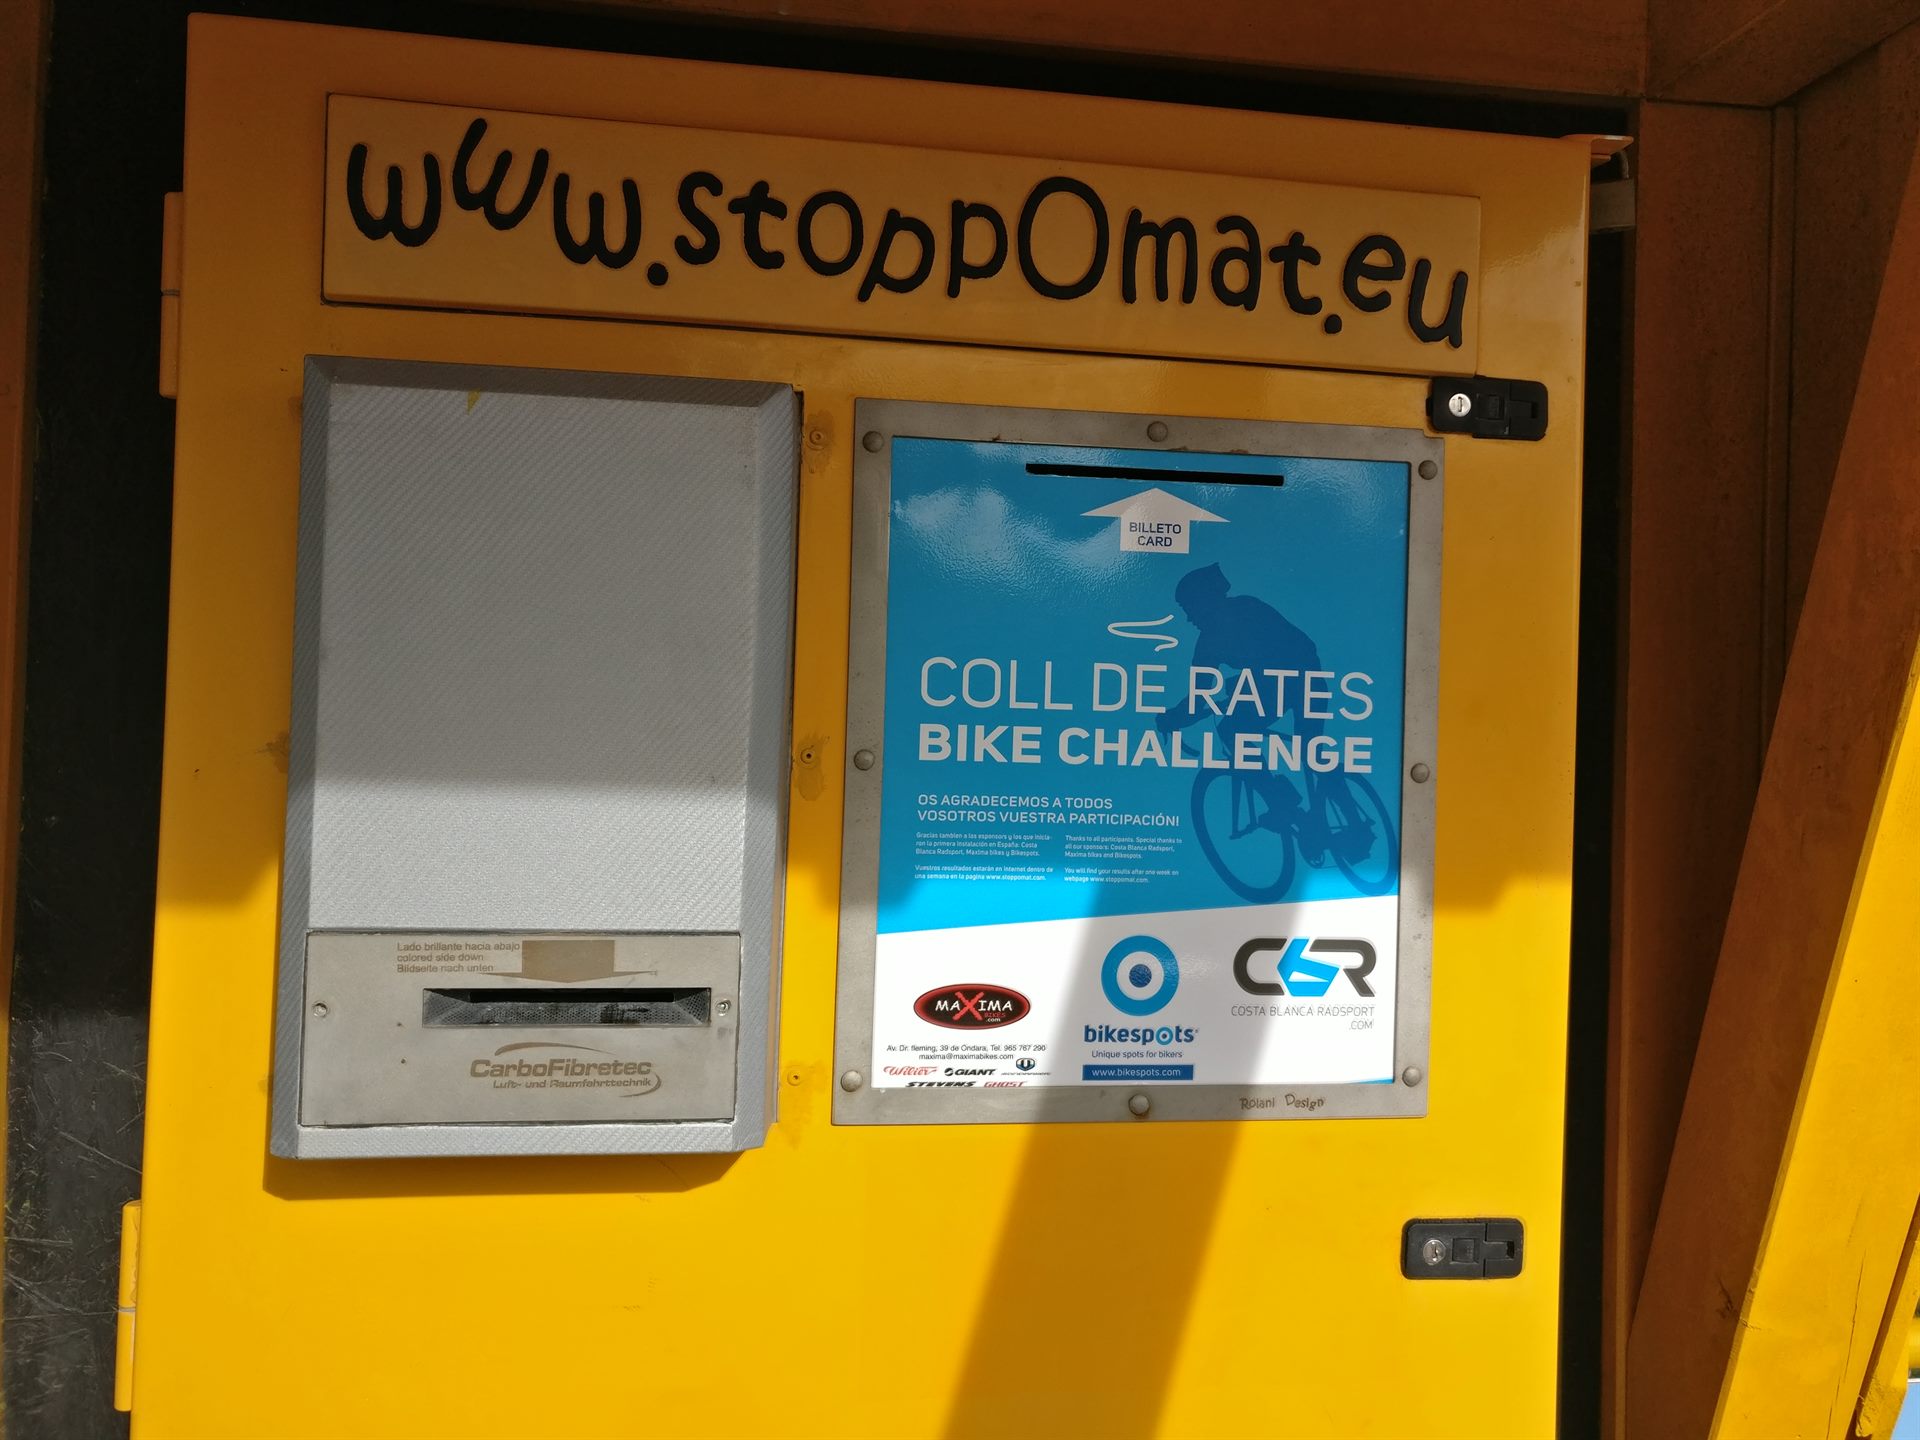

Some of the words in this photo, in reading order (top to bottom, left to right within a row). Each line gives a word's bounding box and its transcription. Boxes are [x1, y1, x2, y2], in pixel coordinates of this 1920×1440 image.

[1129, 522, 1182, 536] BILLETO
[1137, 536, 1172, 548] CARD
[920, 657, 1073, 711] COLL
[1092, 662, 1167, 714] DE
[1188, 666, 1374, 721] RATES
[918, 723, 1042, 764] BIKE
[1058, 728, 1373, 774] CHALLENGE
[918, 794, 938, 806] OS
[941, 795, 1049, 808] AGRADECEMOS
[1052, 797, 1062, 808] A
[1065, 797, 1113, 809] TODOS
[918, 810, 996, 822] VOSOTROS
[1000, 811, 1066, 824] VUESTRA
[1070, 813, 1179, 827] PARTICIPACIÓN!
[397, 942, 421, 951] Lado
[424, 942, 462, 951] brillante
[465, 942, 491, 951] hacia
[494, 942, 520, 952] abajo
[397, 953, 432, 962] colored
[435, 953, 456, 961] side
[458, 953, 483, 961] down
[397, 964, 438, 973] Bildseite
[440, 964, 464, 972] nach
[467, 964, 494, 972] unten
[935, 991, 1012, 1020] MAXIMA
[1231, 1006, 1266, 1017] COSTA
[1270, 1006, 1314, 1017] BLANCA
[1317, 1006, 1375, 1017] RADSPORT
[961, 1044, 988, 1053] Ondara,
[1092, 1050, 1120, 1059] Unique
[1123, 1051, 1144, 1059] spots
[470, 1058, 652, 1078] CarboFibretec
[1092, 1068, 1181, 1077] www.bikespots.com
[493, 1079, 521, 1089] Luft-
[525, 1079, 546, 1089] und
[549, 1078, 651, 1089] Raumfahrttechnik
[1284, 1093, 1325, 1111] Design
